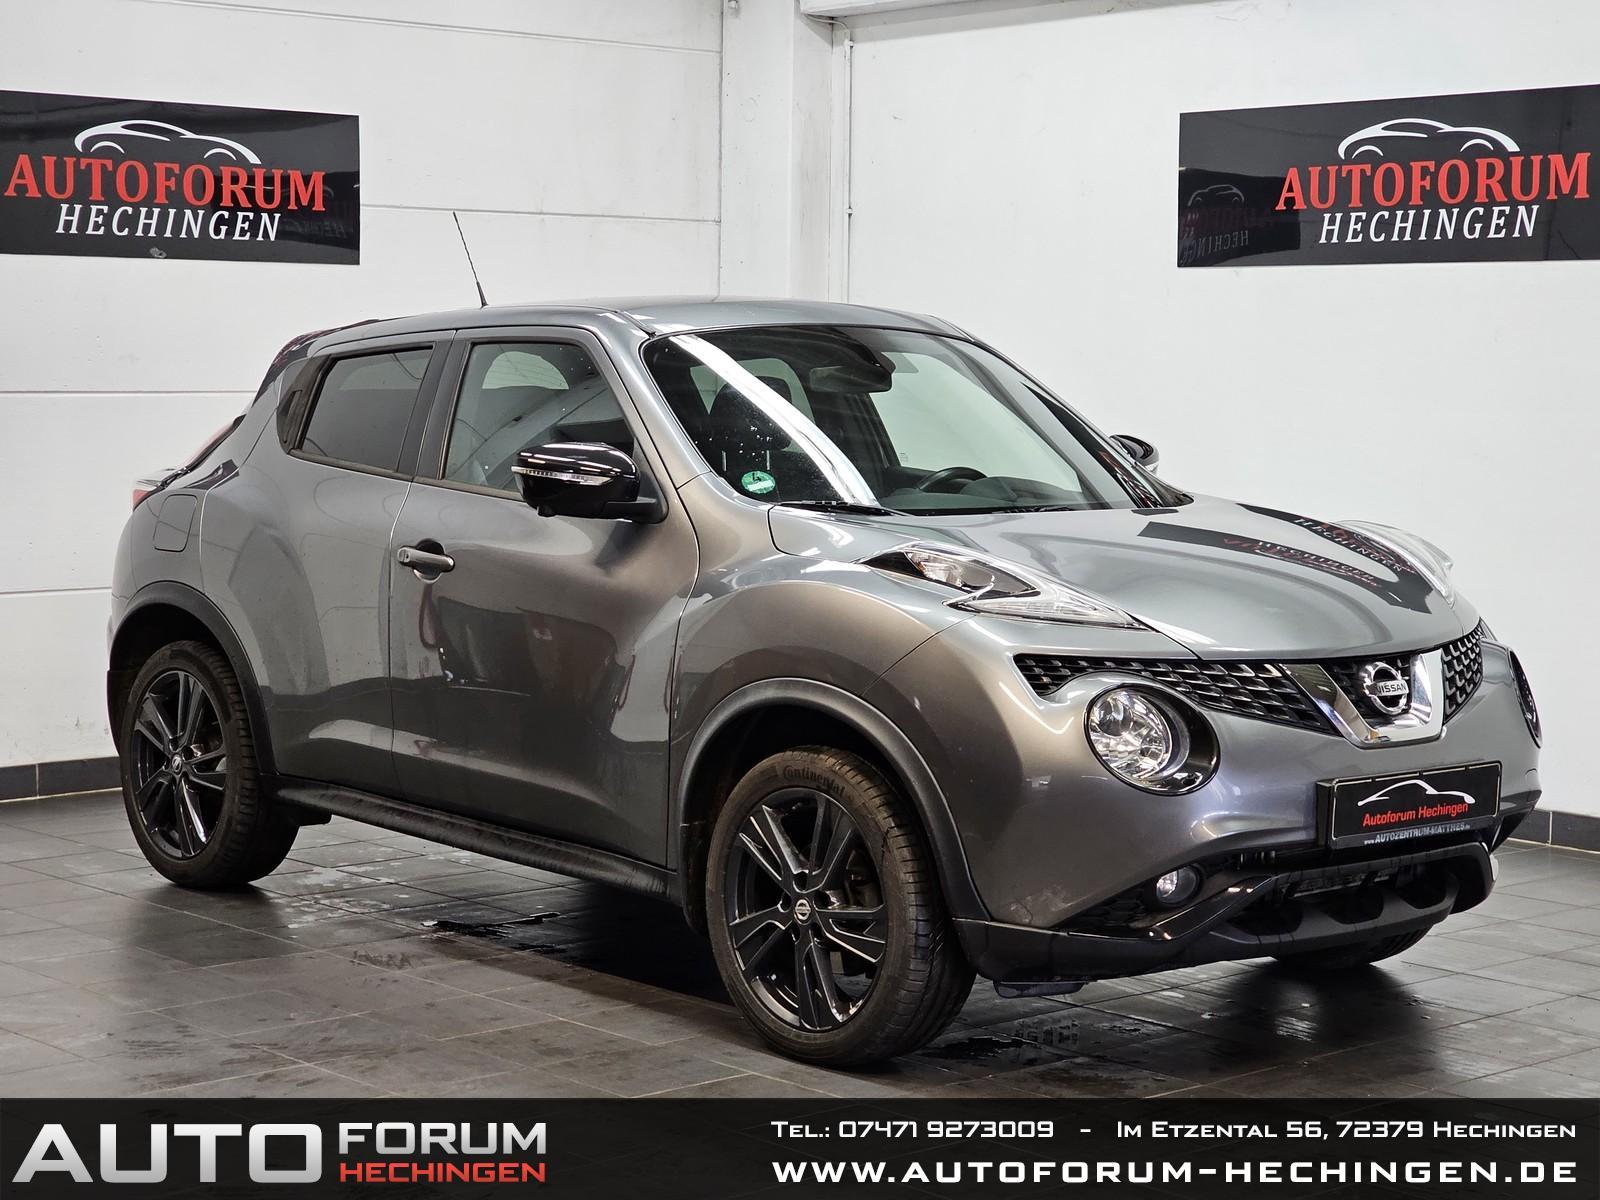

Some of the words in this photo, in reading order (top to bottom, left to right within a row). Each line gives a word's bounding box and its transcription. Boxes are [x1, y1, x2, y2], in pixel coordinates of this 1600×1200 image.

[4, 153, 327, 212] AUTOFORUM
[1275, 151, 1591, 211] AUTOFORUM
[55, 203, 281, 242] HECHINGEN
[1318, 204, 1540, 244] HECHINGEN
[1377, 683, 1407, 694] NISSAN
[1362, 810, 1416, 827] Autoforum
[1418, 802, 1469, 818] Hechingen
